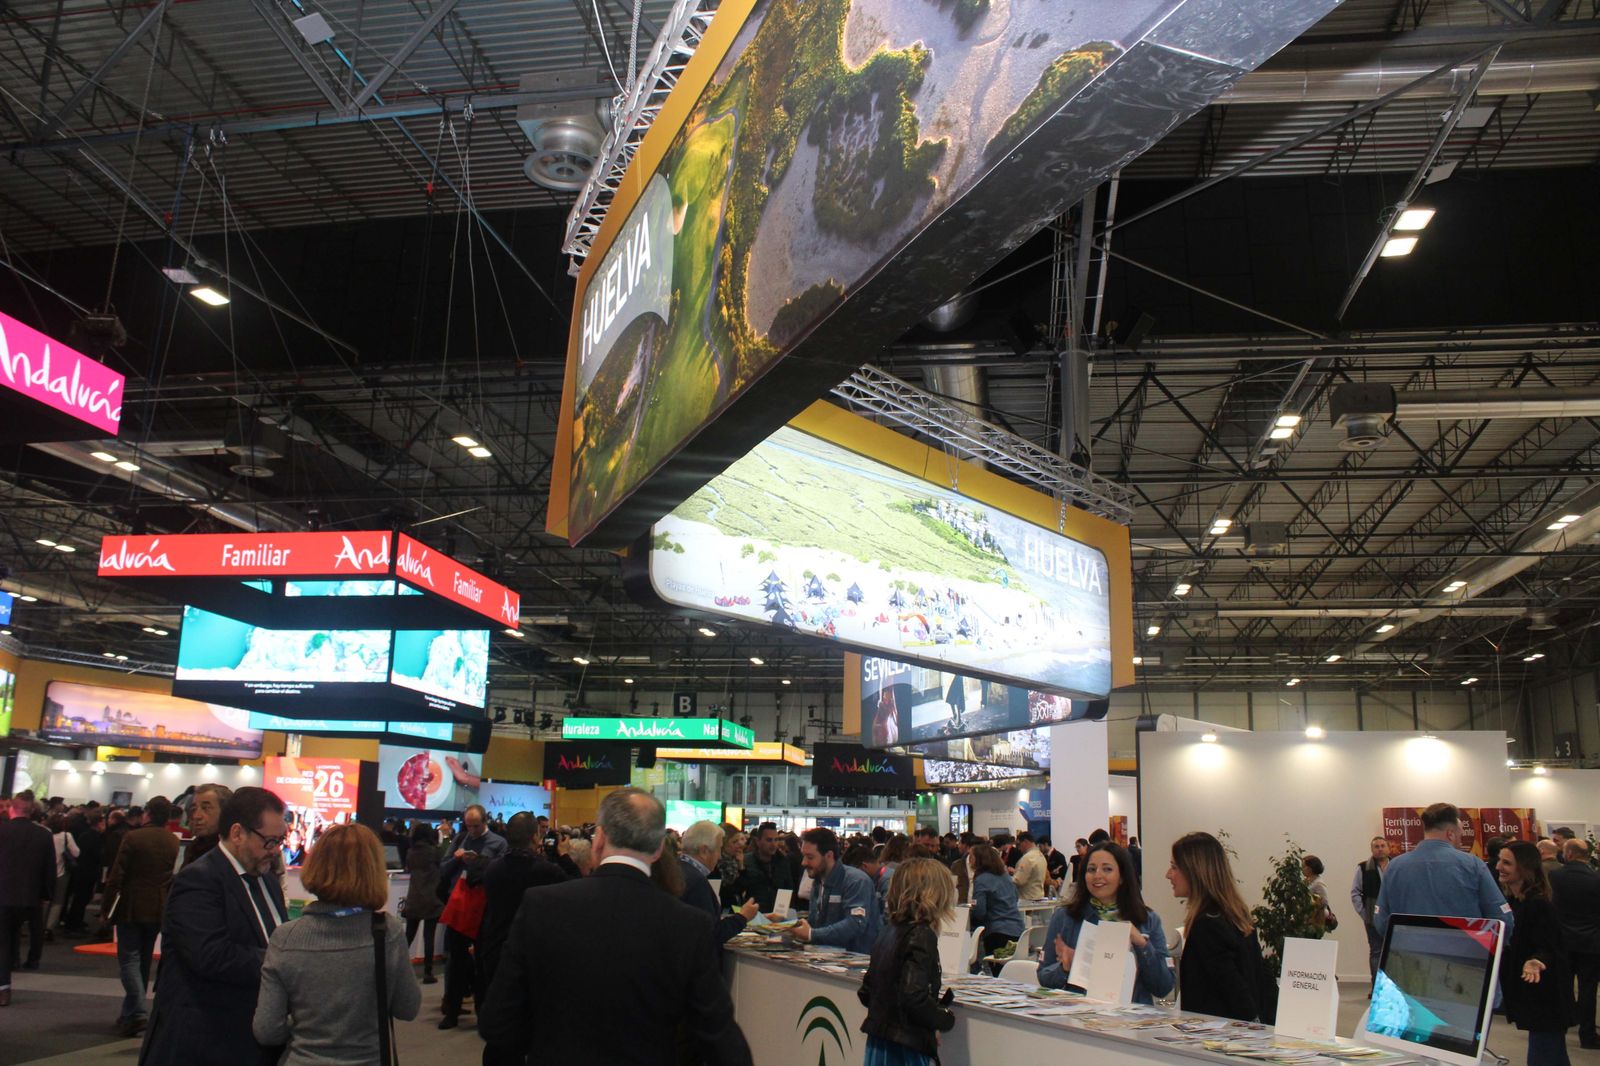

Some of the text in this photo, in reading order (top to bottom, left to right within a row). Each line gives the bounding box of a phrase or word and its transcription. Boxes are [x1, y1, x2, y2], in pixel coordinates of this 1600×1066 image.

[581, 211, 651, 365] HUELVA
[222, 544, 291, 567] Familiar
[1024, 534, 1102, 595] HUELVA
[453, 571, 483, 603] Familiar
[680, 696, 692, 713] B
[616, 720, 685, 738] Andalucía
[1565, 741, 1571, 756] 3
[558, 753, 614, 770] Andalucía
[831, 756, 897, 774] Andalucía
[313, 769, 344, 798] 26
[1385, 818, 1421, 827] Territorio
[1483, 823, 1519, 833] De cine
[1385, 827, 1403, 836] Toro
[1288, 970, 1327, 981] INFORMACIÓN
[1292, 981, 1319, 991] GENERAL
